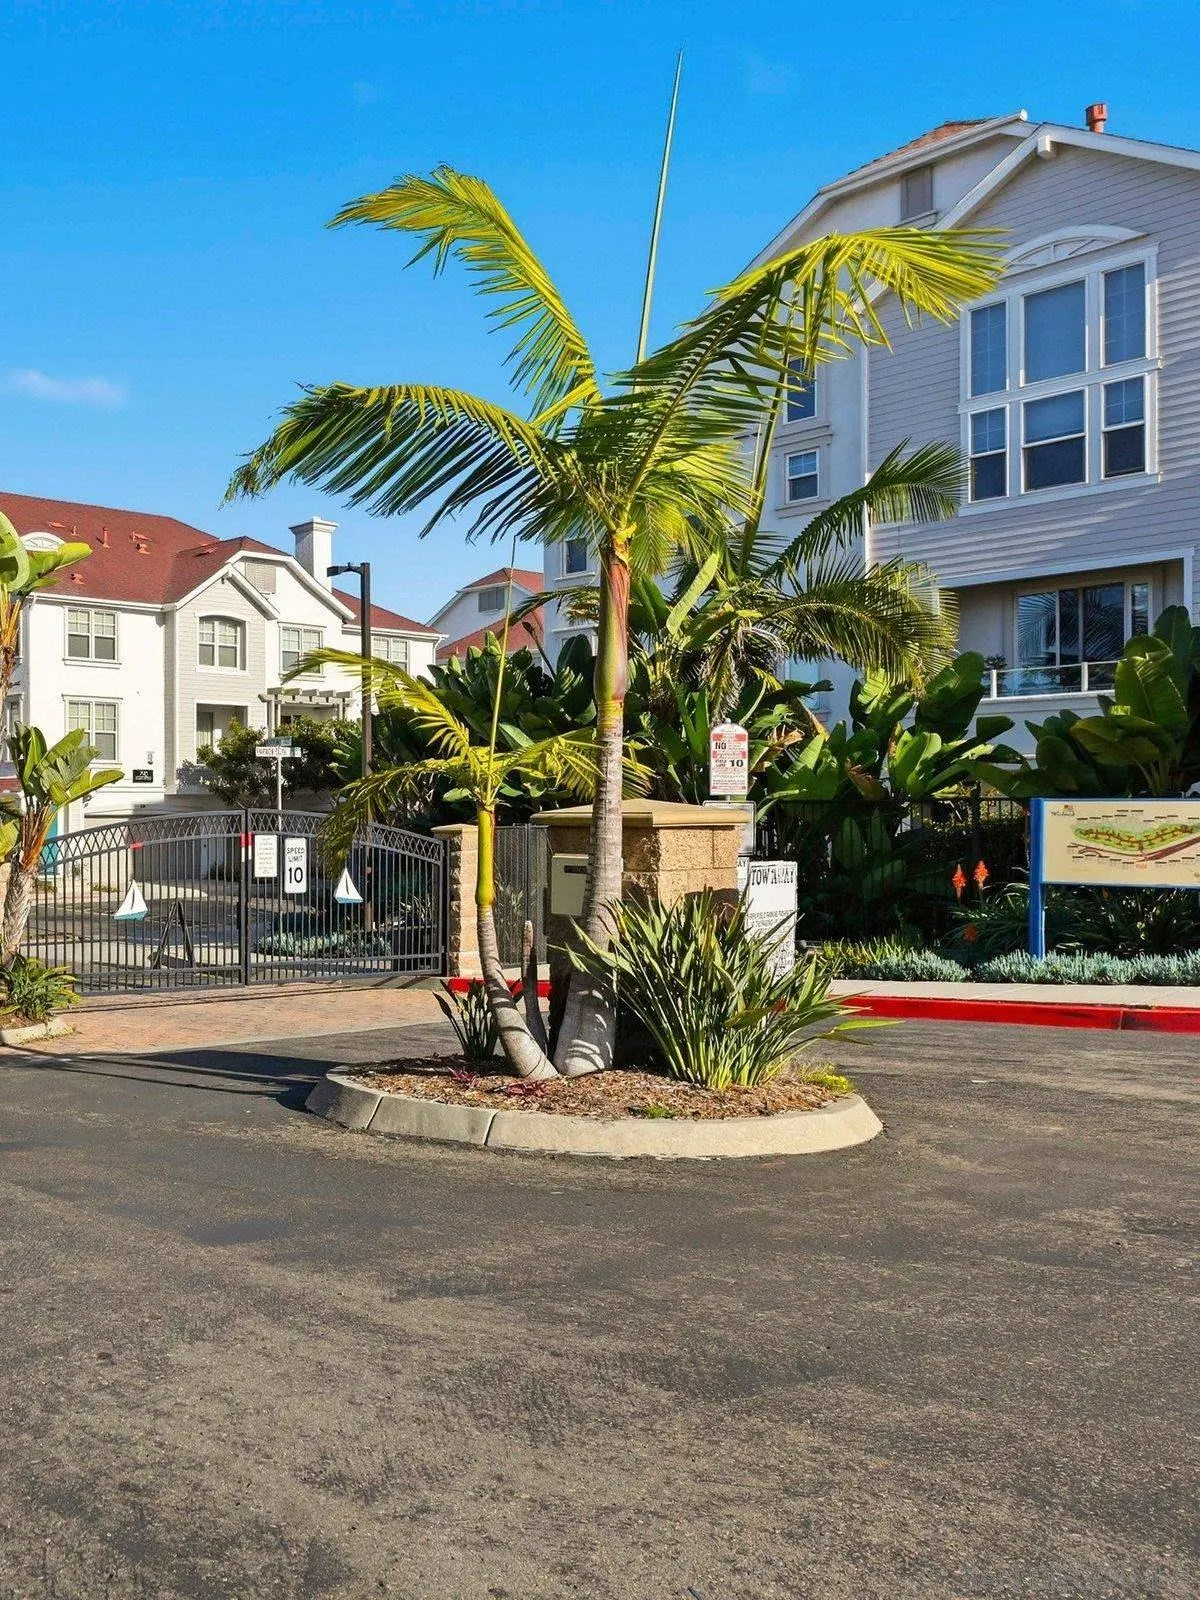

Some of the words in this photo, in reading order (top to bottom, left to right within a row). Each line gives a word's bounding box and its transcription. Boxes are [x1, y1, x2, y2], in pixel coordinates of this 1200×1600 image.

[715, 742, 726, 750] NO
[729, 759, 744, 767] 10
[288, 867, 304, 884] 10
[751, 868, 770, 886] TOW
